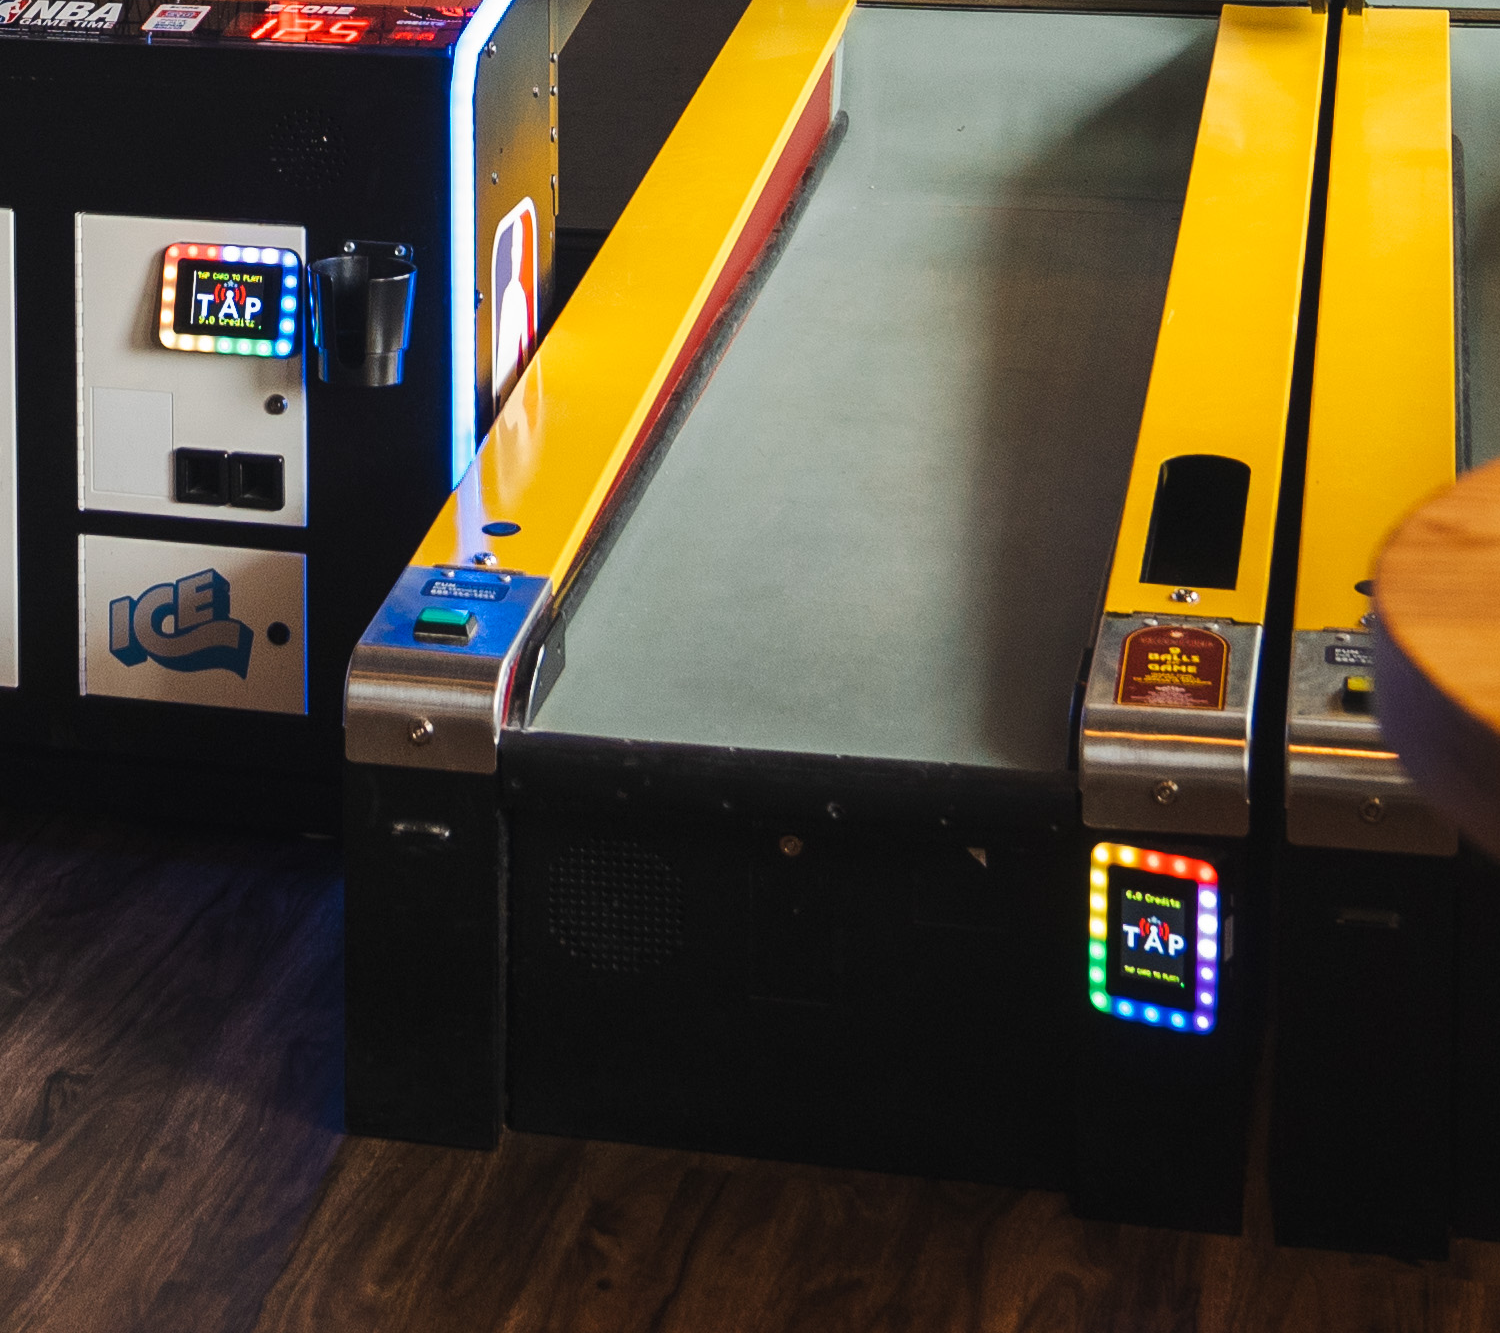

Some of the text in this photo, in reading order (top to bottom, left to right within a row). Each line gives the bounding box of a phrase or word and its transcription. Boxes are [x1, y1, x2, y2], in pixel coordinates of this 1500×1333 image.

[22, 0, 123, 23] NBA
[264, 4, 356, 16] SCORE
[19, 17, 67, 28] GAME
[72, 19, 115, 29] TIME
[251, 18, 371, 43] 125
[196, 289, 262, 321] TAP
[1144, 892, 1182, 910] Credits
[1122, 923, 1185, 957] TAP
